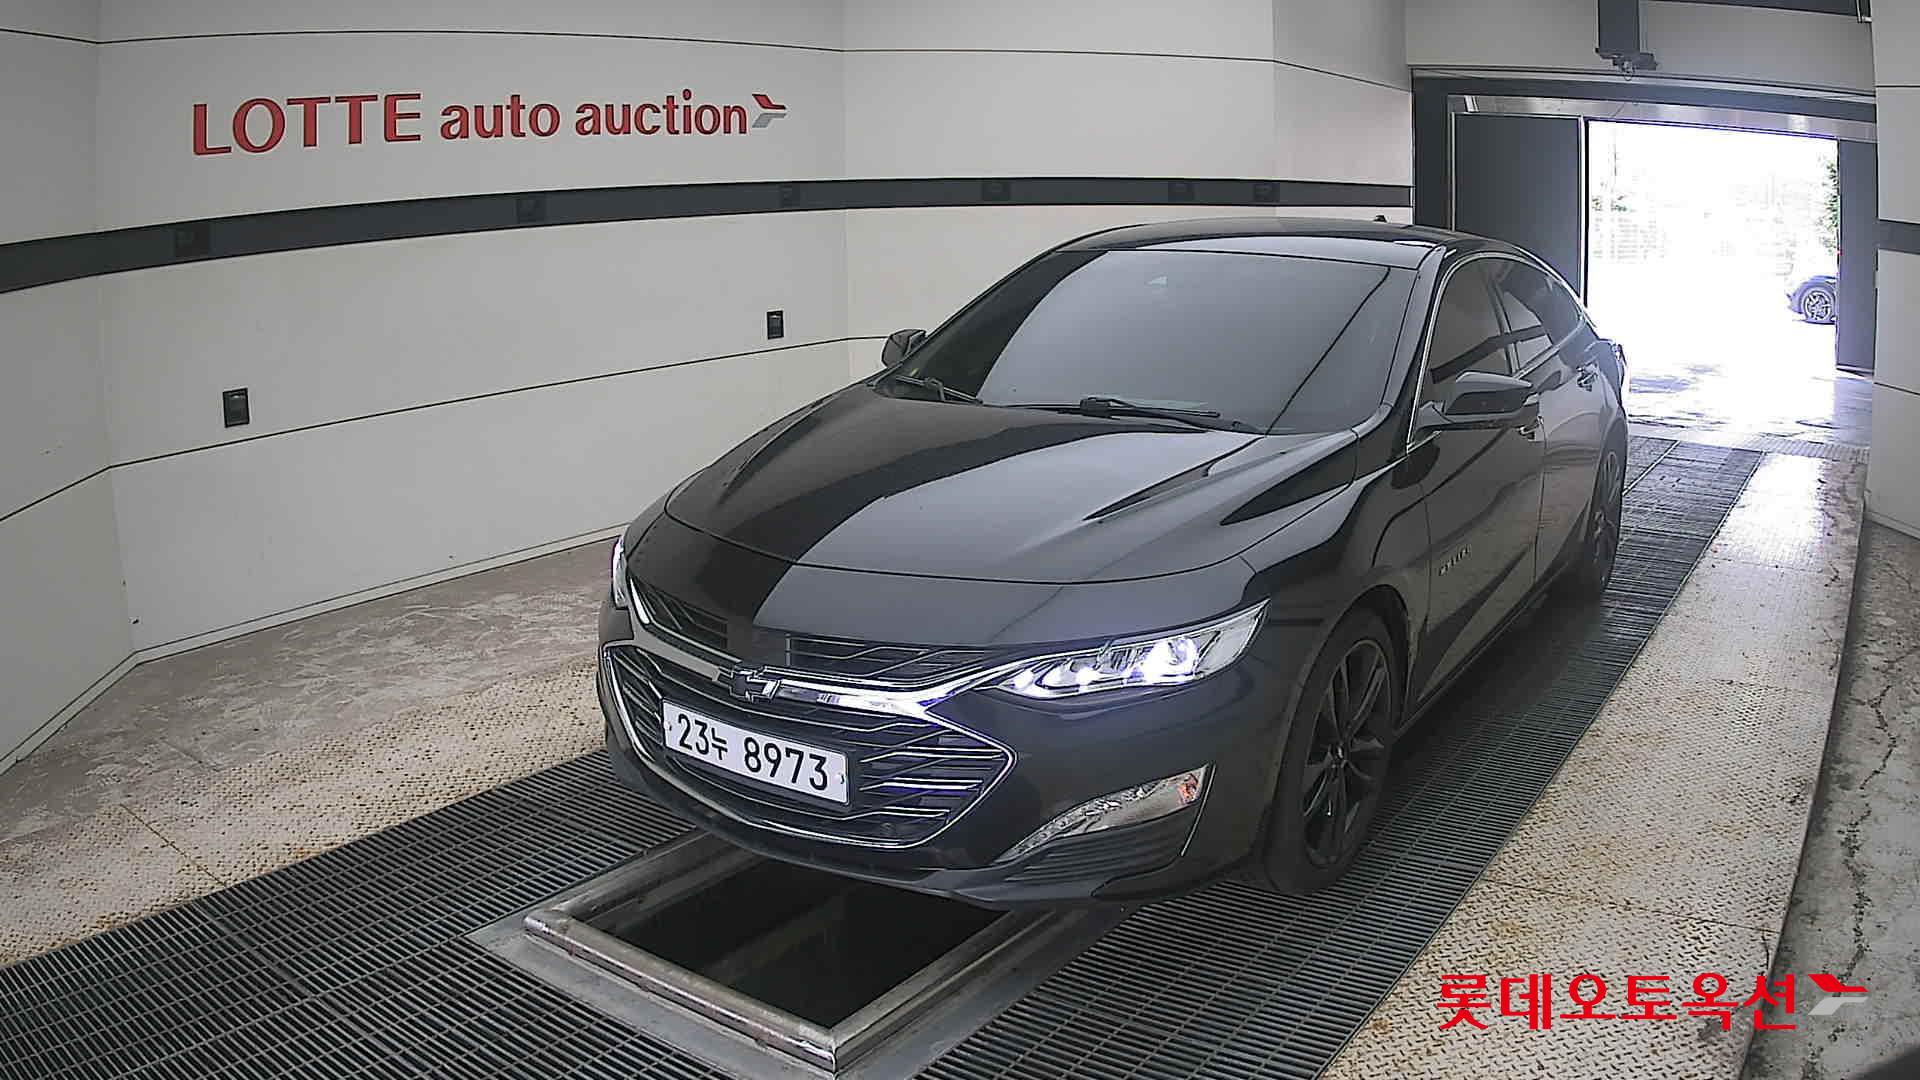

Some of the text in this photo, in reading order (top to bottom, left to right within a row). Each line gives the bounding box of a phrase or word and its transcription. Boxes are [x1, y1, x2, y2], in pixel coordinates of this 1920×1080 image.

[192, 88, 749, 157] LOTTE auto auction
[743, 736, 828, 791] 8973
